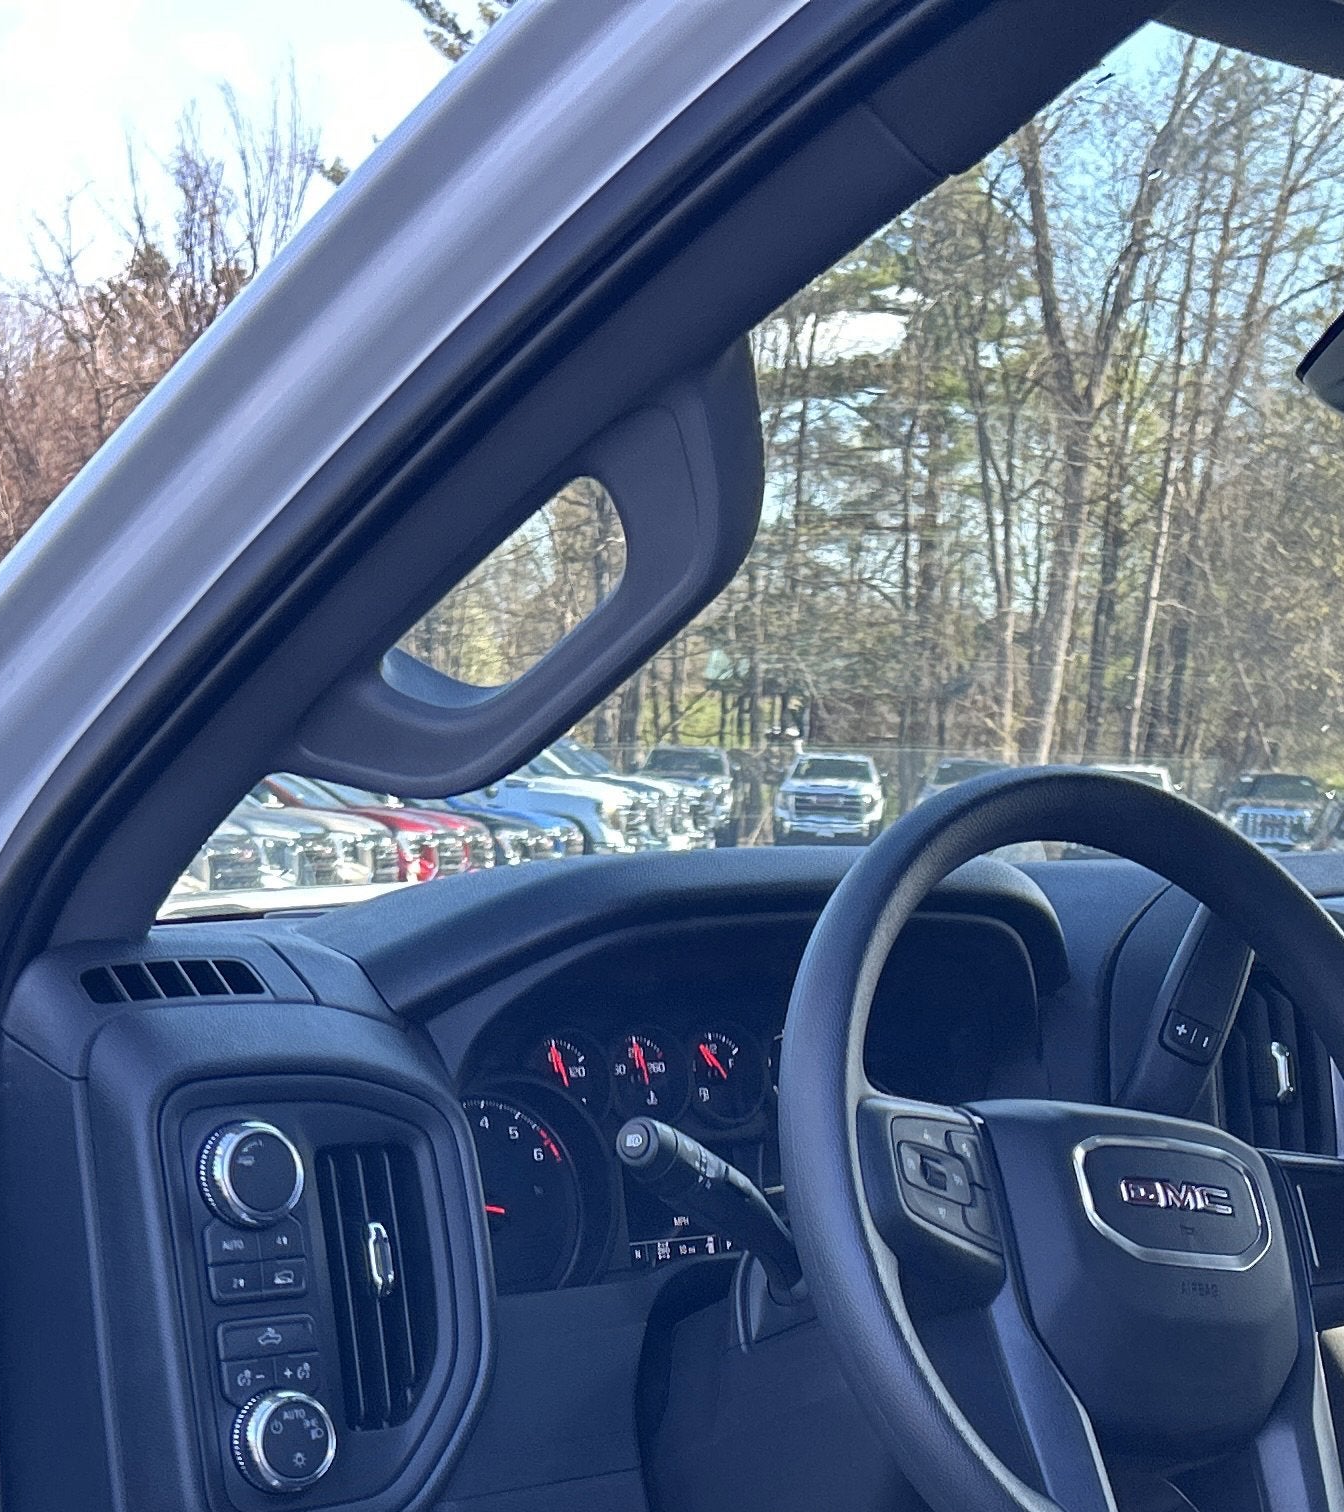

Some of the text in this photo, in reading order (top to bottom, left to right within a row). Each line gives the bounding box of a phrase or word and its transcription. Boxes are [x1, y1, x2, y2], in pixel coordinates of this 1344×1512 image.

[479, 1116, 490, 1129] 4
[508, 1126, 519, 1140] 5
[533, 1147, 545, 1162] 6
[1120, 1178, 1234, 1216] GMC
[673, 1215, 690, 1227] MPH
[283, 1408, 307, 1420] AUTO
